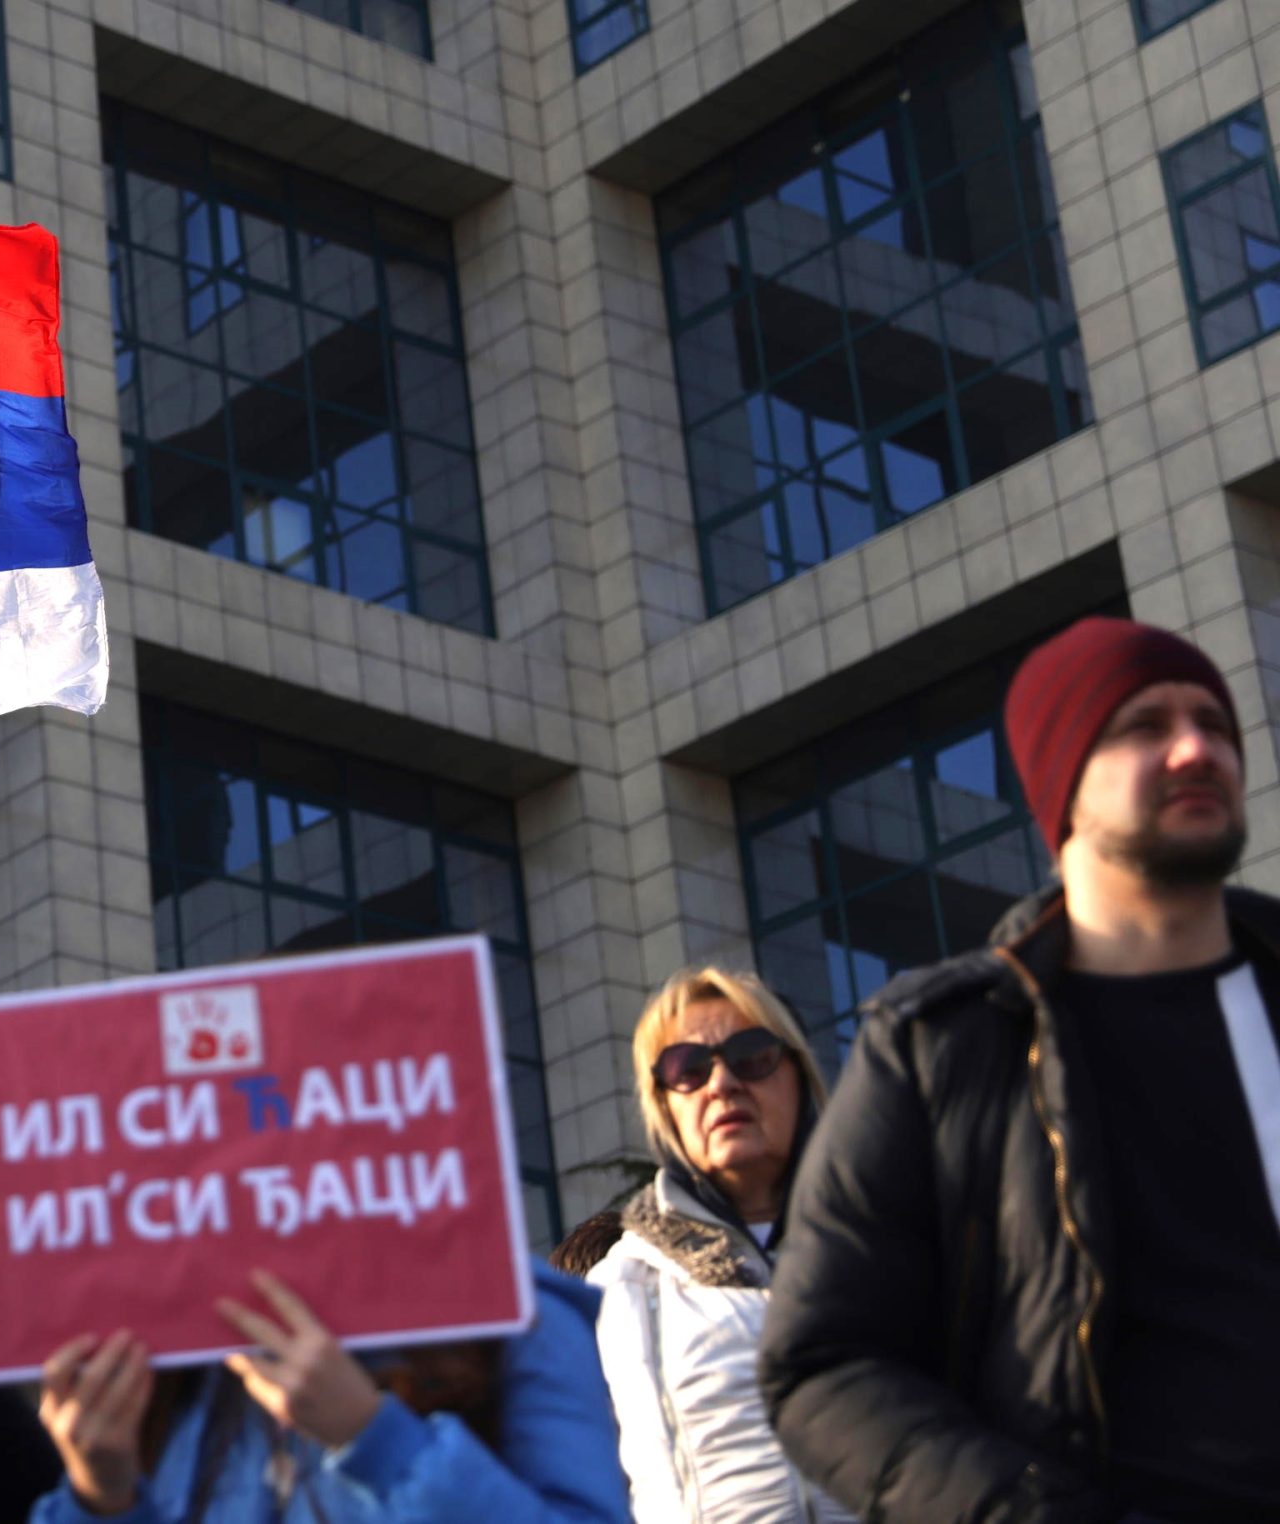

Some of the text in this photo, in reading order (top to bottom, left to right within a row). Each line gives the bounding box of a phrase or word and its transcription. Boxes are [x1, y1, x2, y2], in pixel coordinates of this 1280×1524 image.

[0, 1052, 456, 1163] ИЛ СИ ЋАЦИ
[239, 1147, 467, 1239] ЂАЦИ
